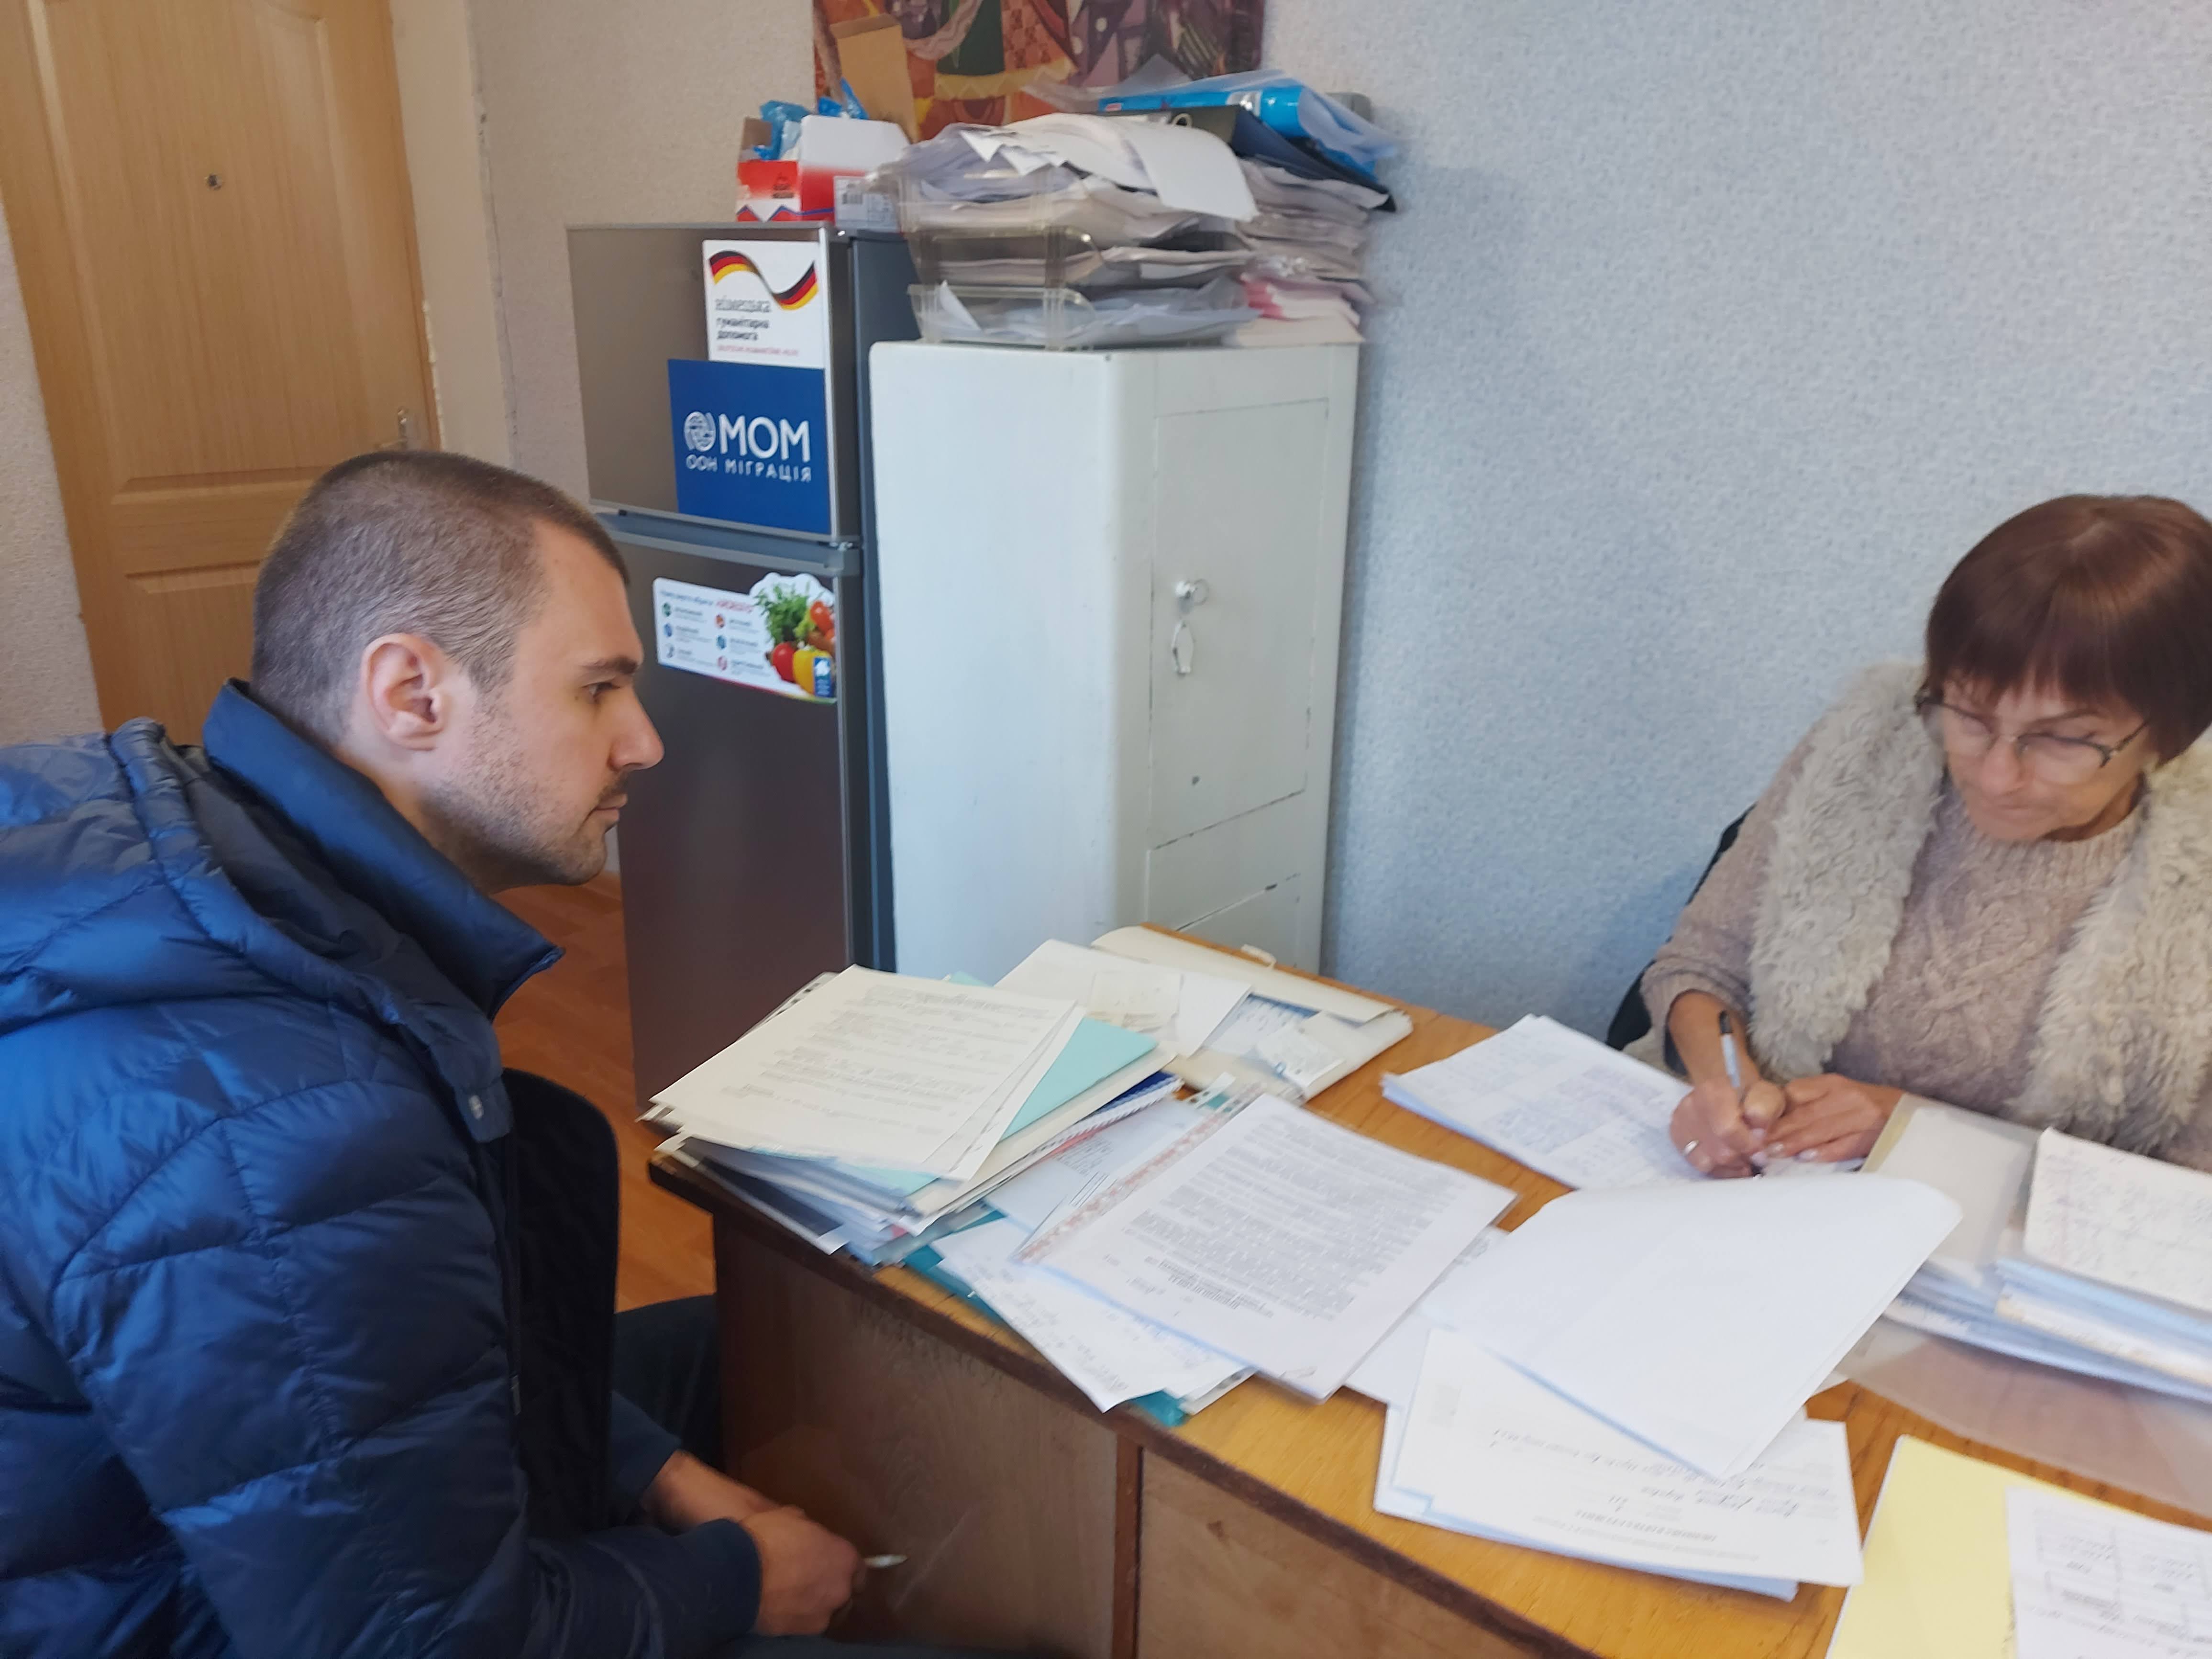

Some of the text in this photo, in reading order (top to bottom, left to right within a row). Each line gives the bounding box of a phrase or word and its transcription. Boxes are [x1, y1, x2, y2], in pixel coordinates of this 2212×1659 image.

[719, 413, 811, 463] МОМ
[686, 454, 812, 483] ООН МІГРАЦІЯ
